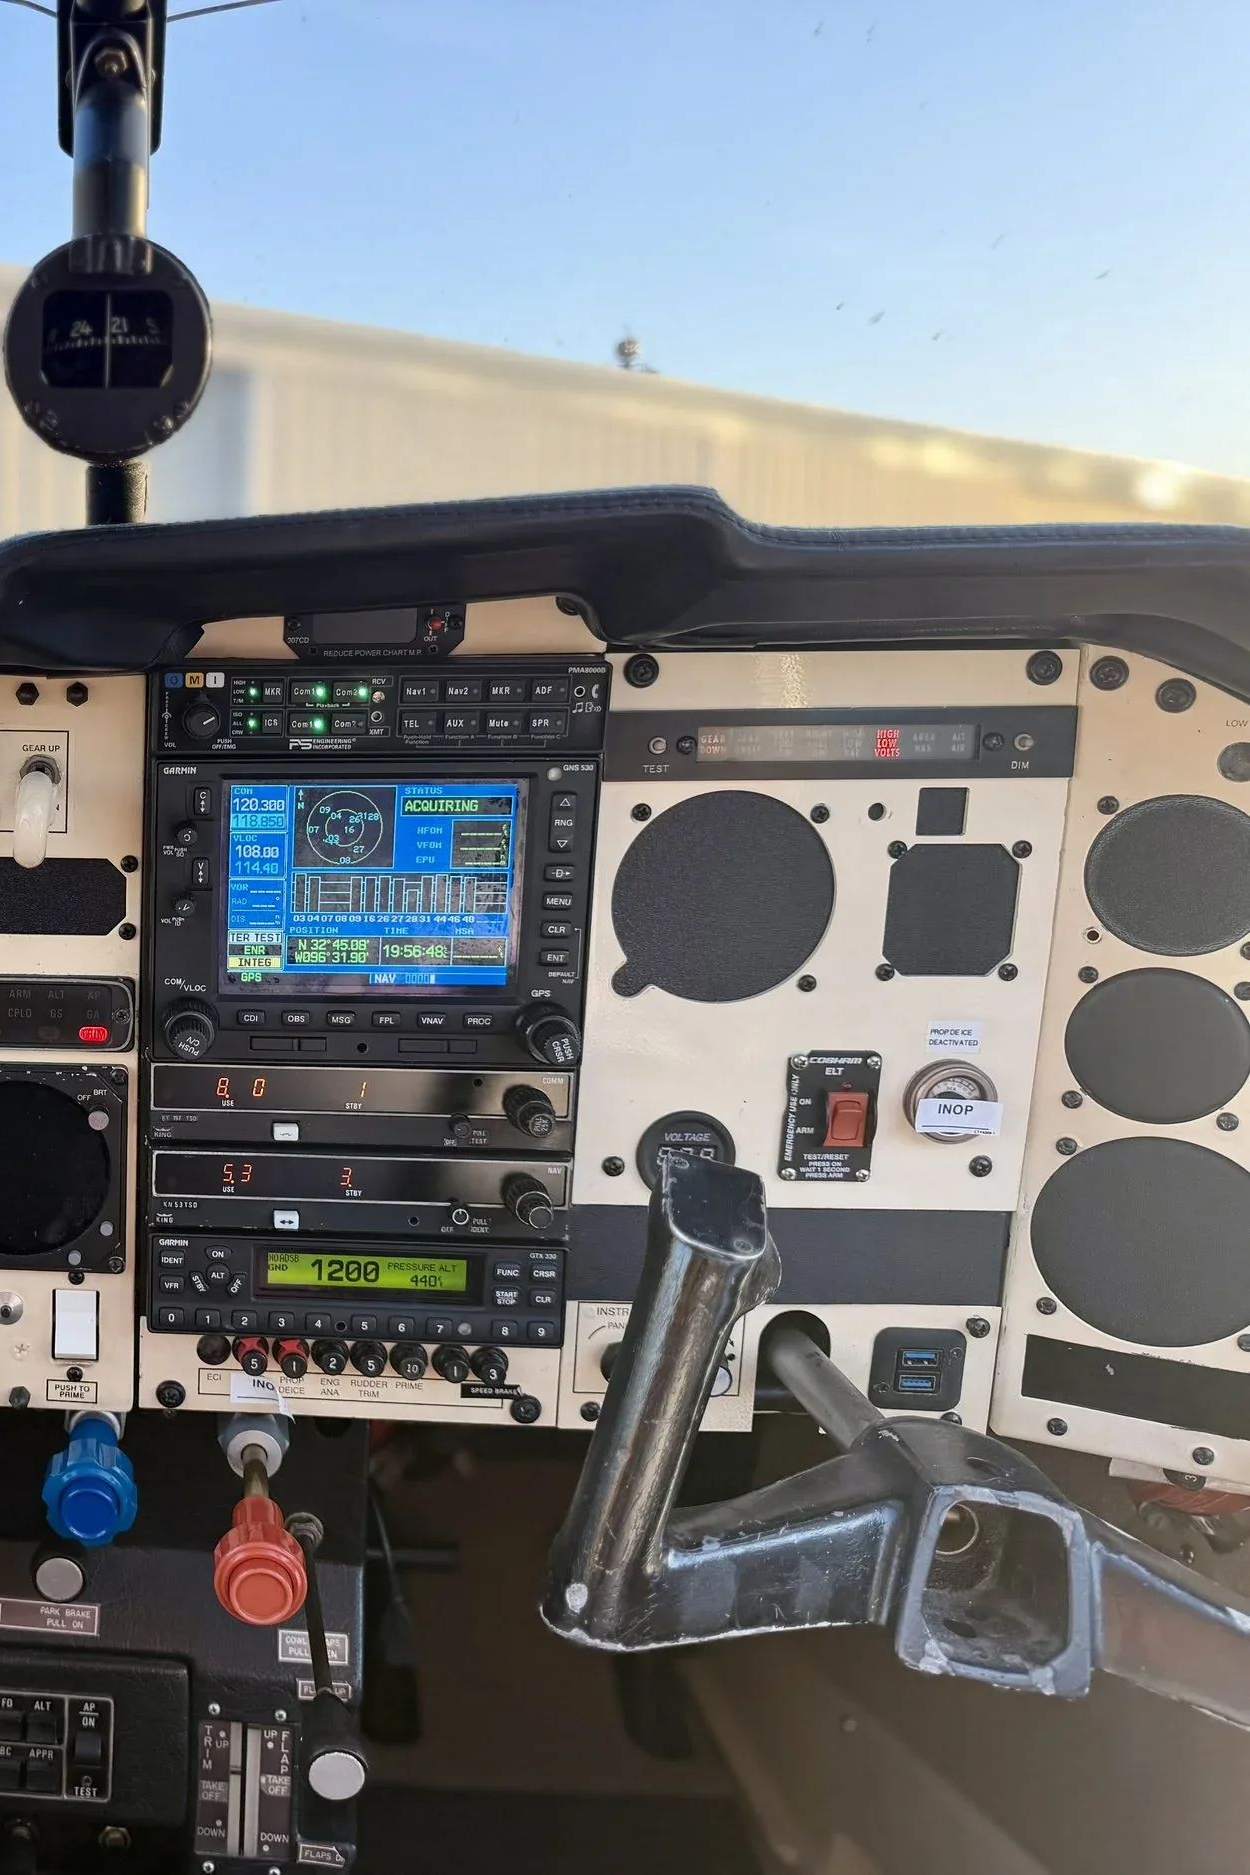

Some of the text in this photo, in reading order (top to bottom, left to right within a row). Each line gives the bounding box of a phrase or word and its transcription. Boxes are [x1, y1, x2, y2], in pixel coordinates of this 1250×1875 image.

[69, 317, 129, 337] 24 21
[406, 686, 553, 696] Nav1 Nav2 MKR ADF
[403, 718, 550, 728] TEL AUX Mute SPR
[876, 729, 900, 739] HIGH
[21, 744, 61, 752] GEAR UP
[877, 739, 897, 748] LOW
[873, 748, 901, 758] VOLTS
[163, 766, 197, 775] GARMIN
[642, 764, 670, 774] TEST
[1010, 761, 1030, 771] DIM
[404, 786, 443, 795] STATUS
[232, 798, 285, 812] 120.300
[404, 799, 479, 813] ACQUIRING
[232, 814, 284, 828] 118.850
[235, 844, 280, 859] 108.00
[235, 861, 279, 874] 114.40
[546, 897, 572, 906] MENU
[289, 926, 339, 934] POSITION
[547, 925, 566, 934] CLR
[243, 945, 266, 955] ENR
[382, 944, 442, 959] 19:56:48
[237, 957, 272, 967] INTEG
[546, 953, 565, 962] ENT
[240, 972, 262, 982] GPS
[374, 973, 396, 984] NAV
[530, 989, 551, 998] GPS
[243, 1014, 491, 1026] CDI OBS MSG FPL VNAV PROC
[928, 1038, 979, 1047] DEACTIVATED
[824, 1067, 844, 1076] ELT
[937, 1103, 974, 1116] INOP
[663, 1132, 711, 1142] VOLTAGE
[802, 1153, 849, 1161] TEST/RESET
[158, 1238, 189, 1247] GARMIN
[161, 1256, 183, 1265] IDENT
[310, 1258, 380, 1283] 1200
[386, 1262, 457, 1272] PRESSURE ALT
[496, 1268, 520, 1277] FUNC
[532, 1270, 556, 1278] CRSR
[191, 1274, 207, 1293] STBY
[230, 1278, 243, 1294] OFF
[320, 1377, 341, 1387] ENG
[350, 1378, 389, 1388] RUDDER
[394, 1381, 424, 1391] PRIME
[54, 1384, 90, 1393] PUSH TO
[278, 1386, 306, 1395] DEICE
[320, 1388, 340, 1397] ANA
[357, 1389, 380, 1398] TRIM
[59, 1391, 85, 1399] PRIME
[39, 1606, 92, 1618] PARK BRAKE
[46, 1617, 84, 1630] PULL ON
[1, 1698, 13, 1708] FD
[33, 1701, 51, 1711] ALT
[0, 1746, 12, 1756] BC
[28, 1749, 54, 1760] APPR
[266, 1775, 291, 1785] TAKE
[201, 1781, 226, 1791] TAKE
[267, 1785, 288, 1795] OFF
[74, 1786, 98, 1797] TEST
[197, 1827, 226, 1838] DOWN
[259, 1832, 290, 1844] DOWN
[304, 1849, 332, 1860] FLAPS
